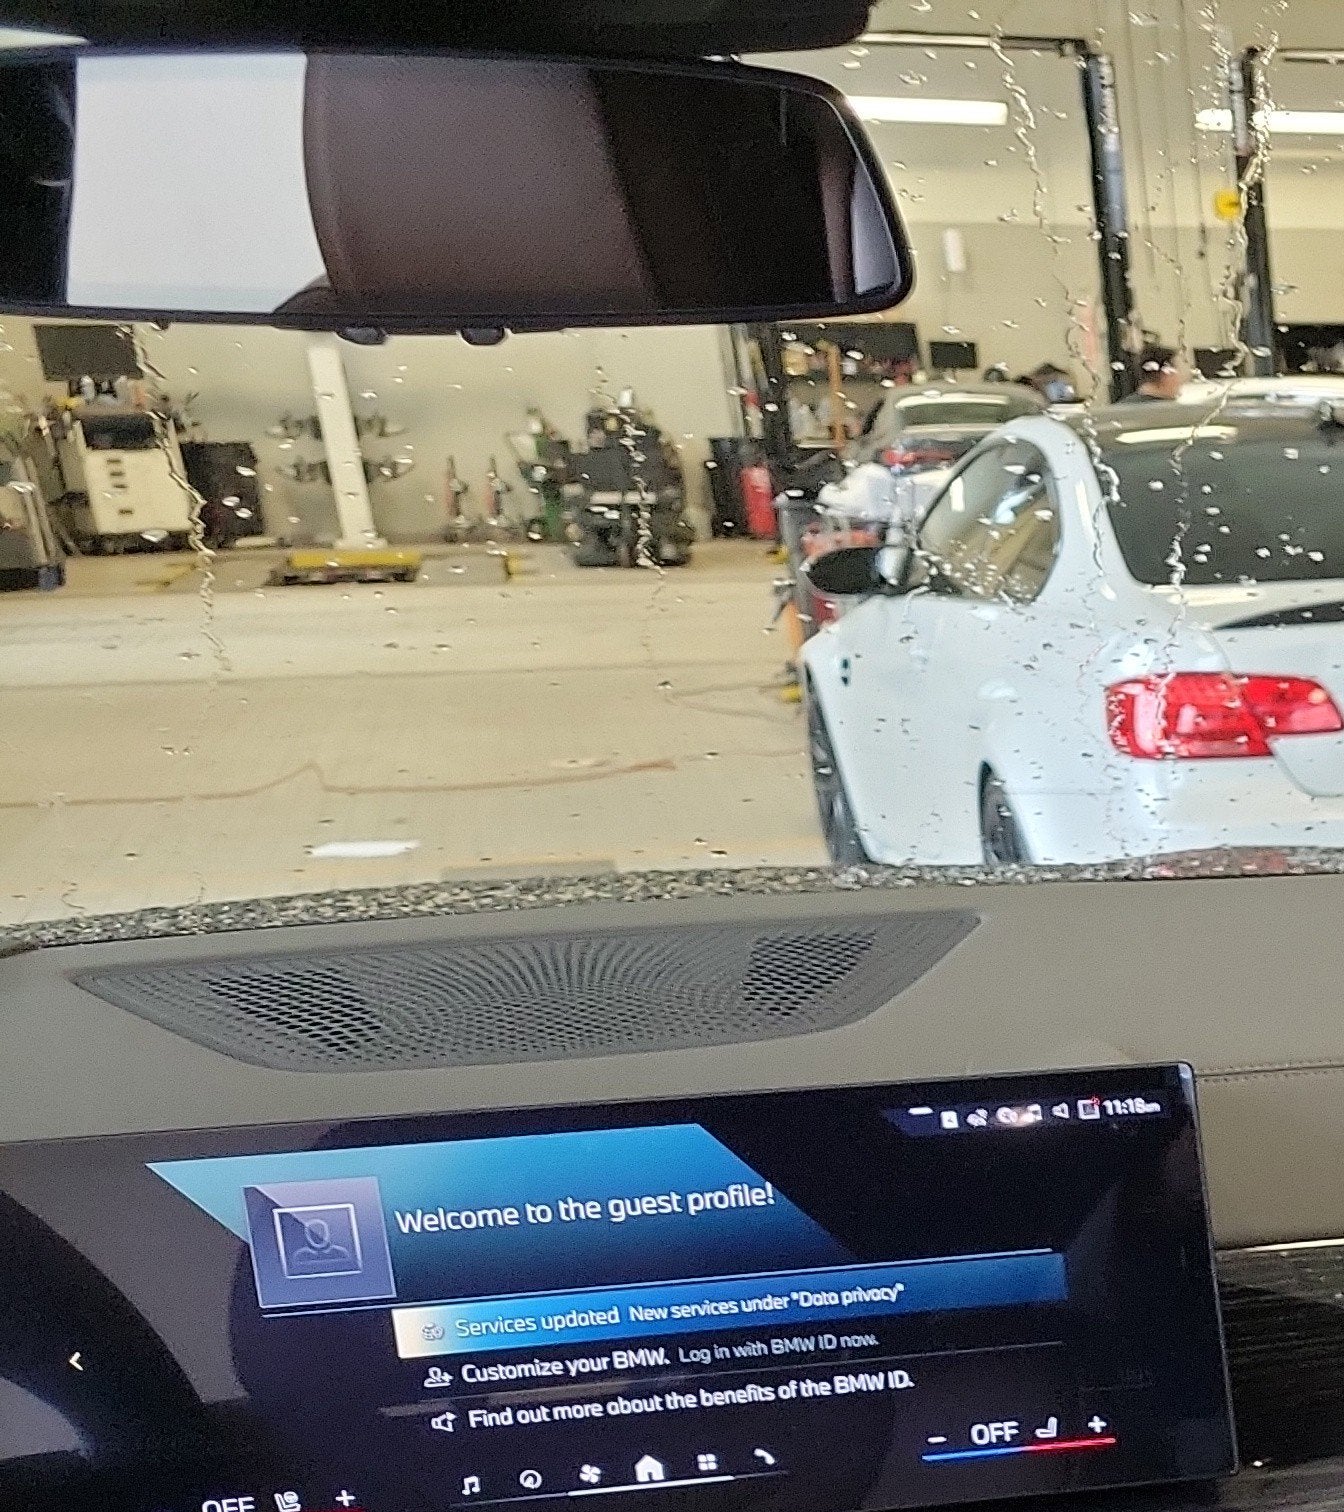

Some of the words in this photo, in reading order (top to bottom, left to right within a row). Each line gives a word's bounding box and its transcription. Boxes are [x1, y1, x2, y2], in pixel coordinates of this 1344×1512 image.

[395, 1204, 520, 1235] Welcome
[525, 1203, 554, 1224] to
[558, 1196, 602, 1223] the
[608, 1192, 682, 1223] guest
[686, 1181, 775, 1217] profile!
[454, 1316, 537, 1338] Services
[540, 1306, 620, 1331] updated
[628, 1306, 668, 1322] New
[670, 1300, 739, 1318] services
[740, 1293, 790, 1313] under
[461, 1356, 564, 1385] Customize
[566, 1357, 611, 1382] your
[612, 1347, 671, 1371] BMW.
[677, 1347, 711, 1366] Log
[714, 1343, 731, 1361] in
[731, 1339, 769, 1359] with
[770, 1335, 816, 1356] BMW
[818, 1333, 838, 1351] ID
[840, 1332, 880, 1350] now.
[467, 1406, 515, 1430] Find
[515, 1405, 552, 1426] out
[552, 1401, 606, 1422] more
[606, 1392, 664, 1417] about
[665, 1391, 698, 1411] the
[699, 1383, 776, 1408] benefits
[776, 1379, 799, 1401] of
[799, 1377, 833, 1398] the
[833, 1371, 886, 1395] BMW
[887, 1369, 916, 1389] ID.
[969, 1420, 1020, 1447] OFF
